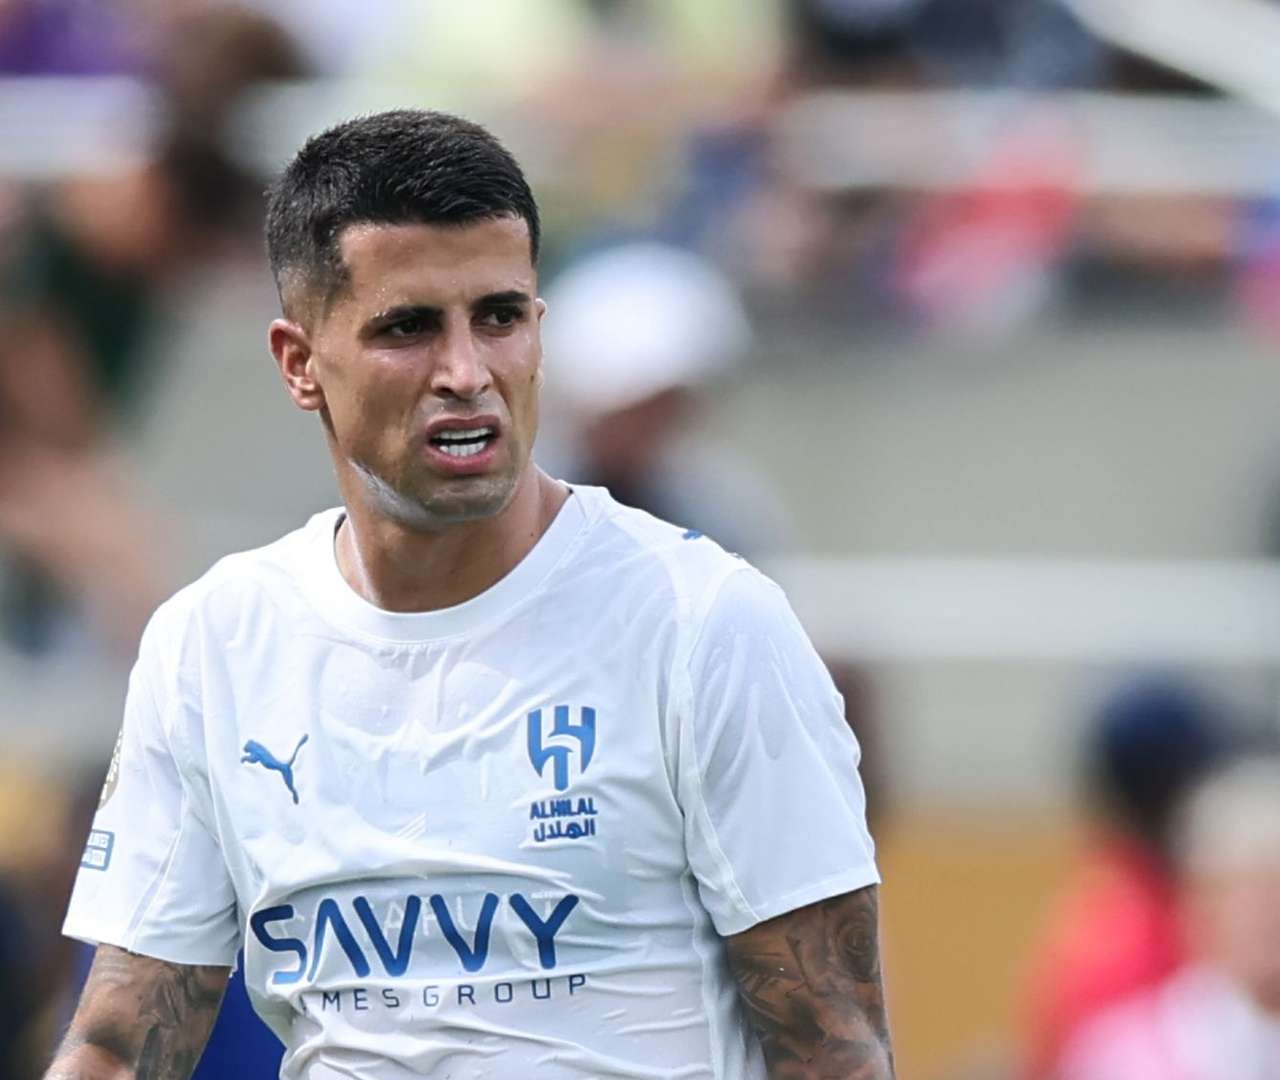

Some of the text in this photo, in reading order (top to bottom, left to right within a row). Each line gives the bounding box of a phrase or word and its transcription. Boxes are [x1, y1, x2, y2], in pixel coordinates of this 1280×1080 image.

[530, 798, 598, 820] ALHILAL
[250, 892, 580, 985] SAVVY
[422, 974, 586, 1007] GROUP
